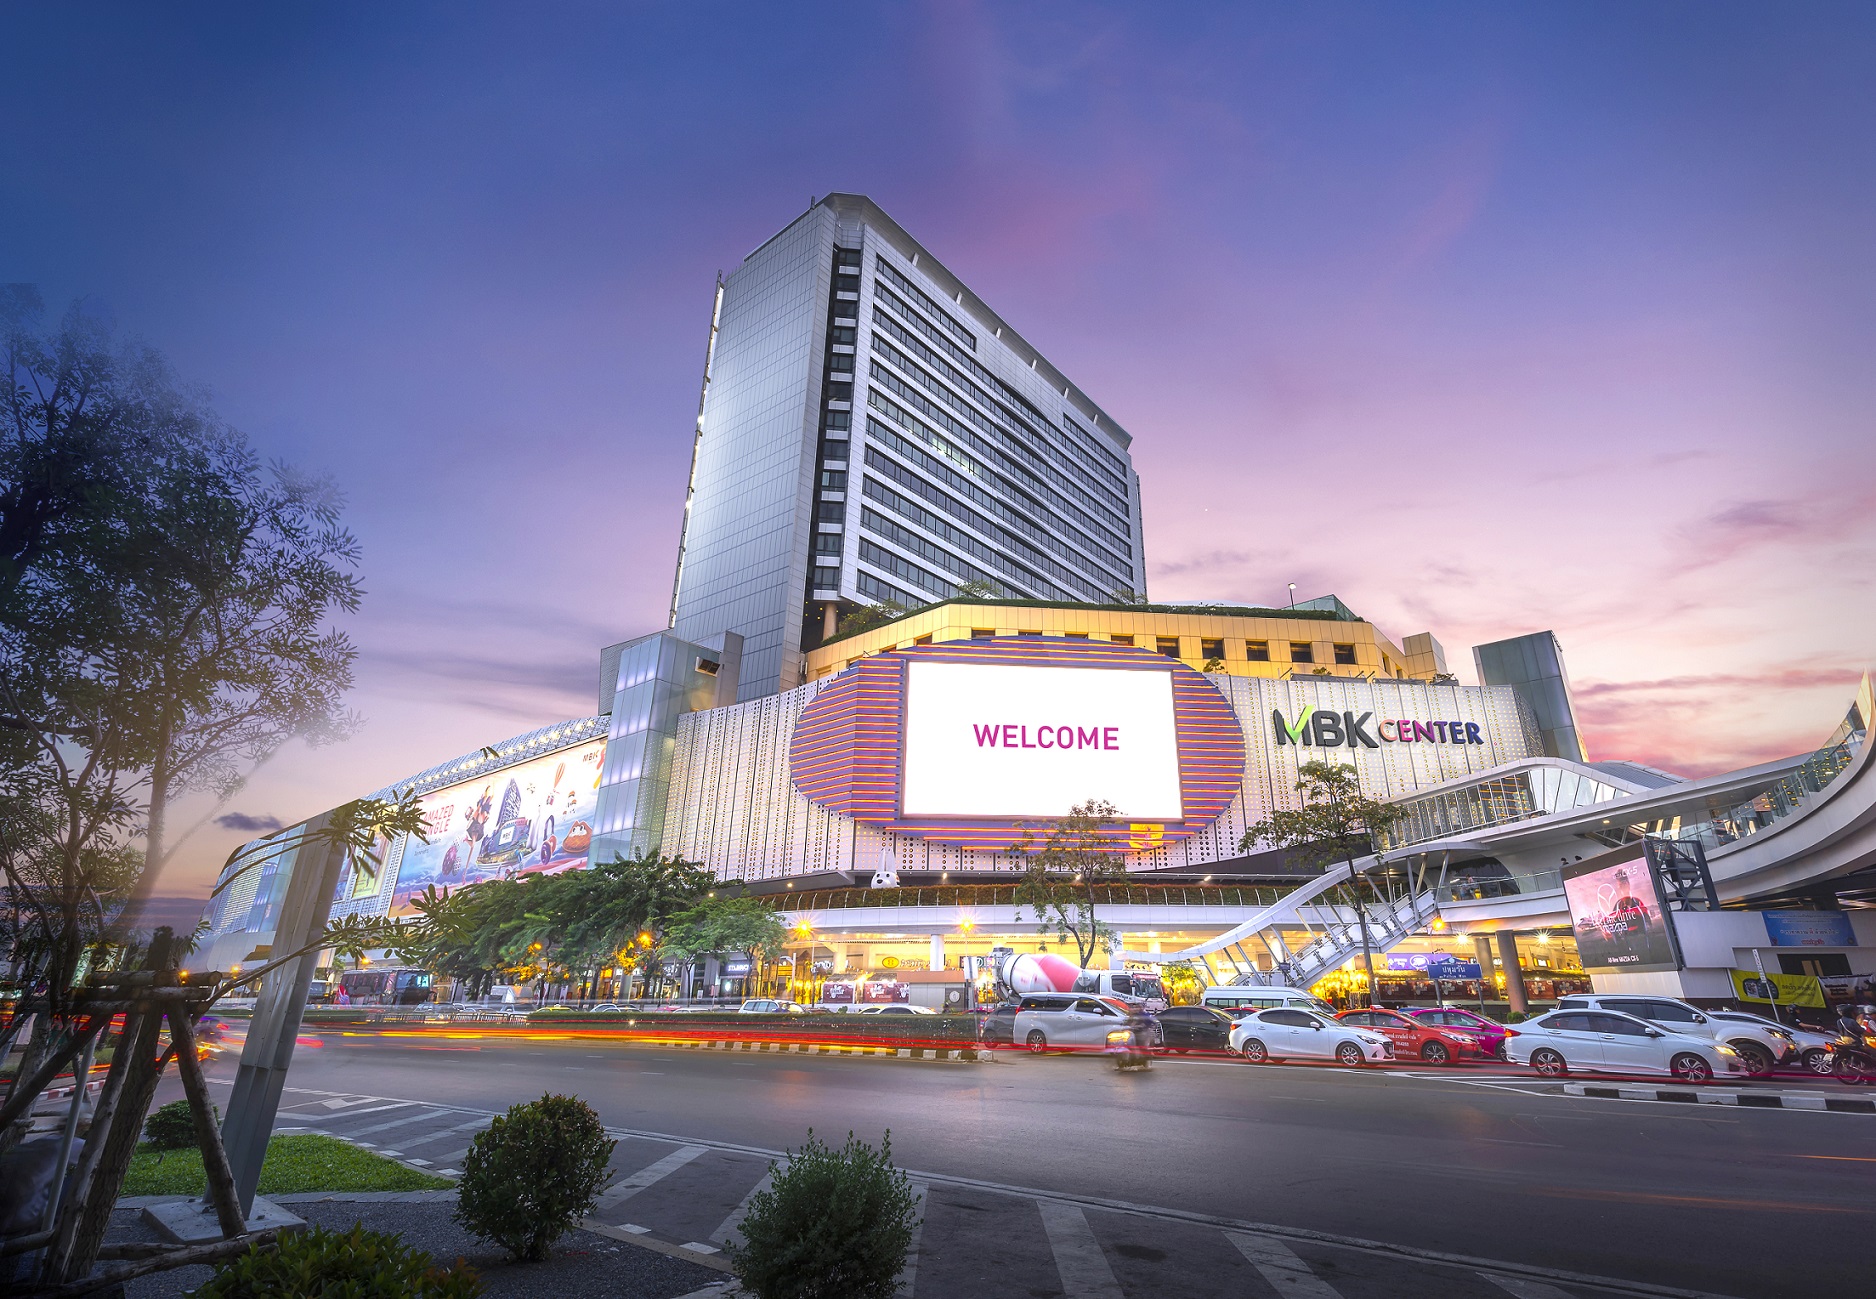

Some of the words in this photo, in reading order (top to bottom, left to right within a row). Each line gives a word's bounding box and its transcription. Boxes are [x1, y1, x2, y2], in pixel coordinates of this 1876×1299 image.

[1273, 704, 1379, 748] MBK
[1378, 719, 1485, 745] CENTER
[973, 724, 1120, 750] WELCOME
[423, 805, 455, 822] AMAZED
[1442, 965, 1466, 975] ปทุมวัน
